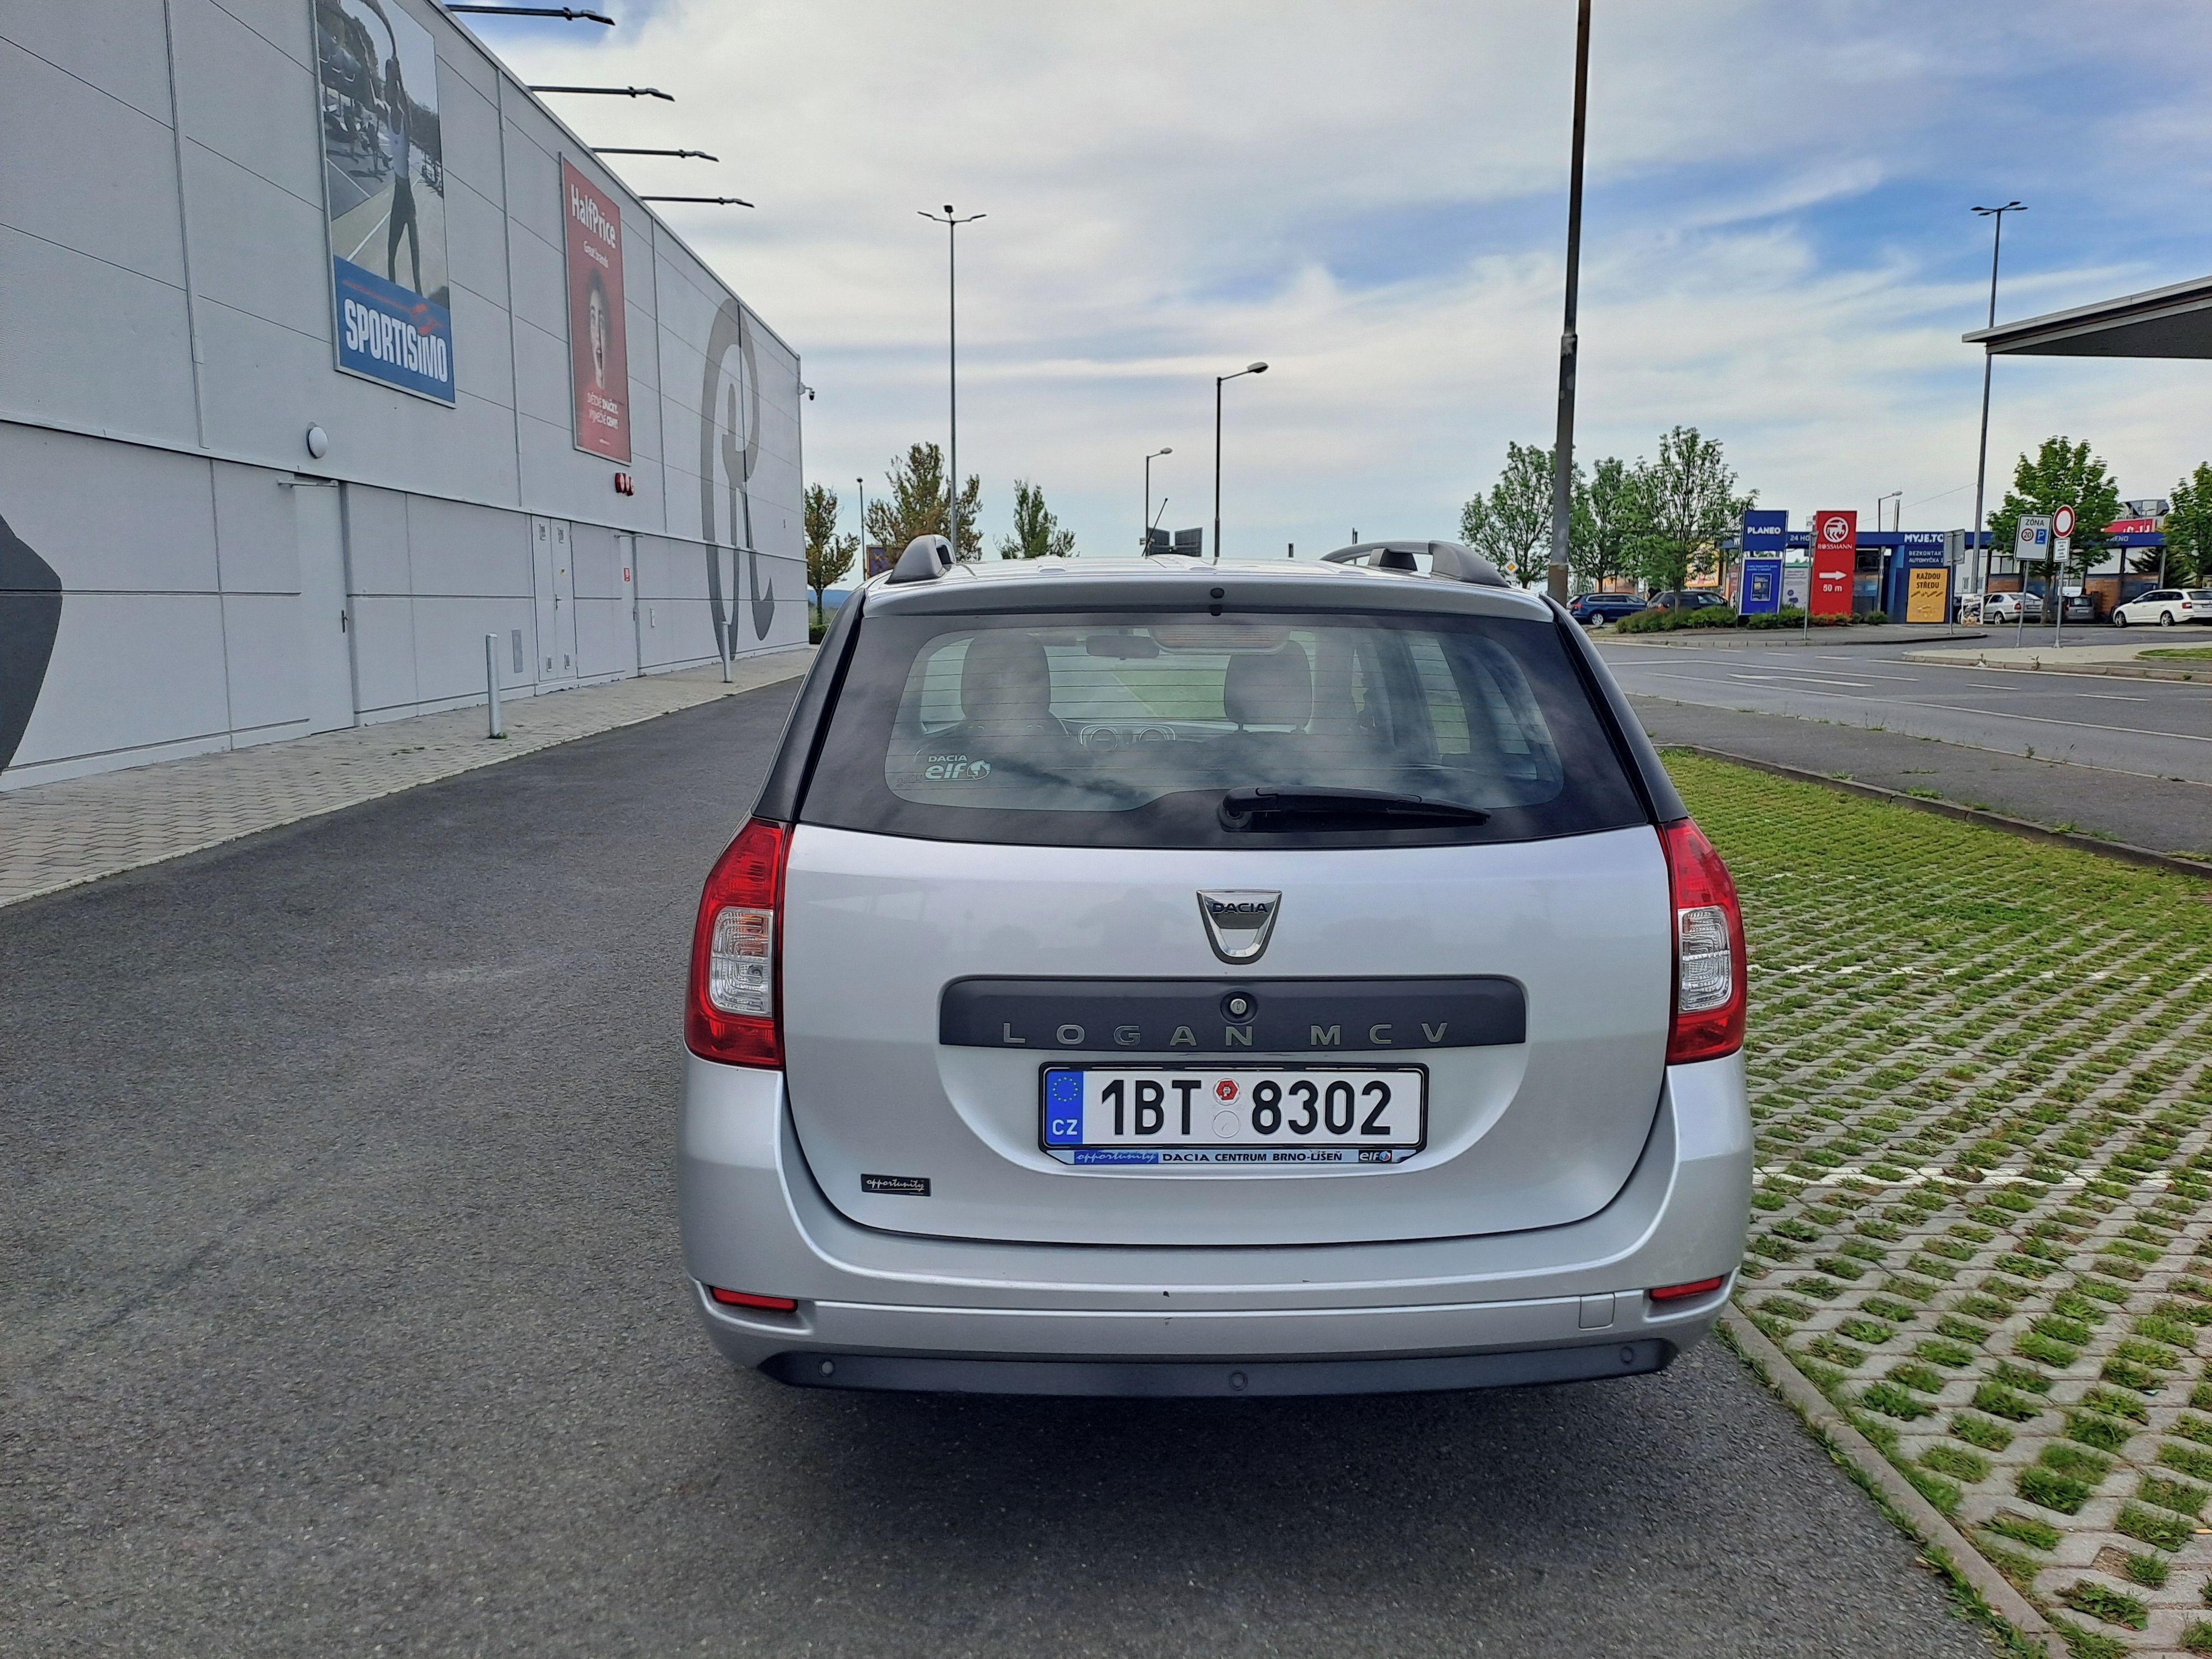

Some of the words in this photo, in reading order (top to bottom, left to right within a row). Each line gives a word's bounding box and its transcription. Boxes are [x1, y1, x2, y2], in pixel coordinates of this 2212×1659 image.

[571, 184, 615, 248] HalfPrice
[344, 299, 448, 383] SPORTISIMO
[1747, 526, 1781, 535] PLANEO
[928, 754, 968, 763] DACIA
[924, 763, 968, 780] elf
[1212, 902, 1268, 913] DACIA
[1003, 1022, 1254, 1047] LOGAN
[1310, 1022, 1448, 1046] MCV
[1102, 1079, 1202, 1135] 1BT
[1251, 1080, 1391, 1135] 8302
[1052, 1119, 1078, 1135] CZ
[1076, 1151, 1157, 1164] opportunity
[1215, 1153, 1266, 1161] CENTRUM
[1359, 1151, 1380, 1161] elf
[867, 1178, 925, 1192] opportunity
